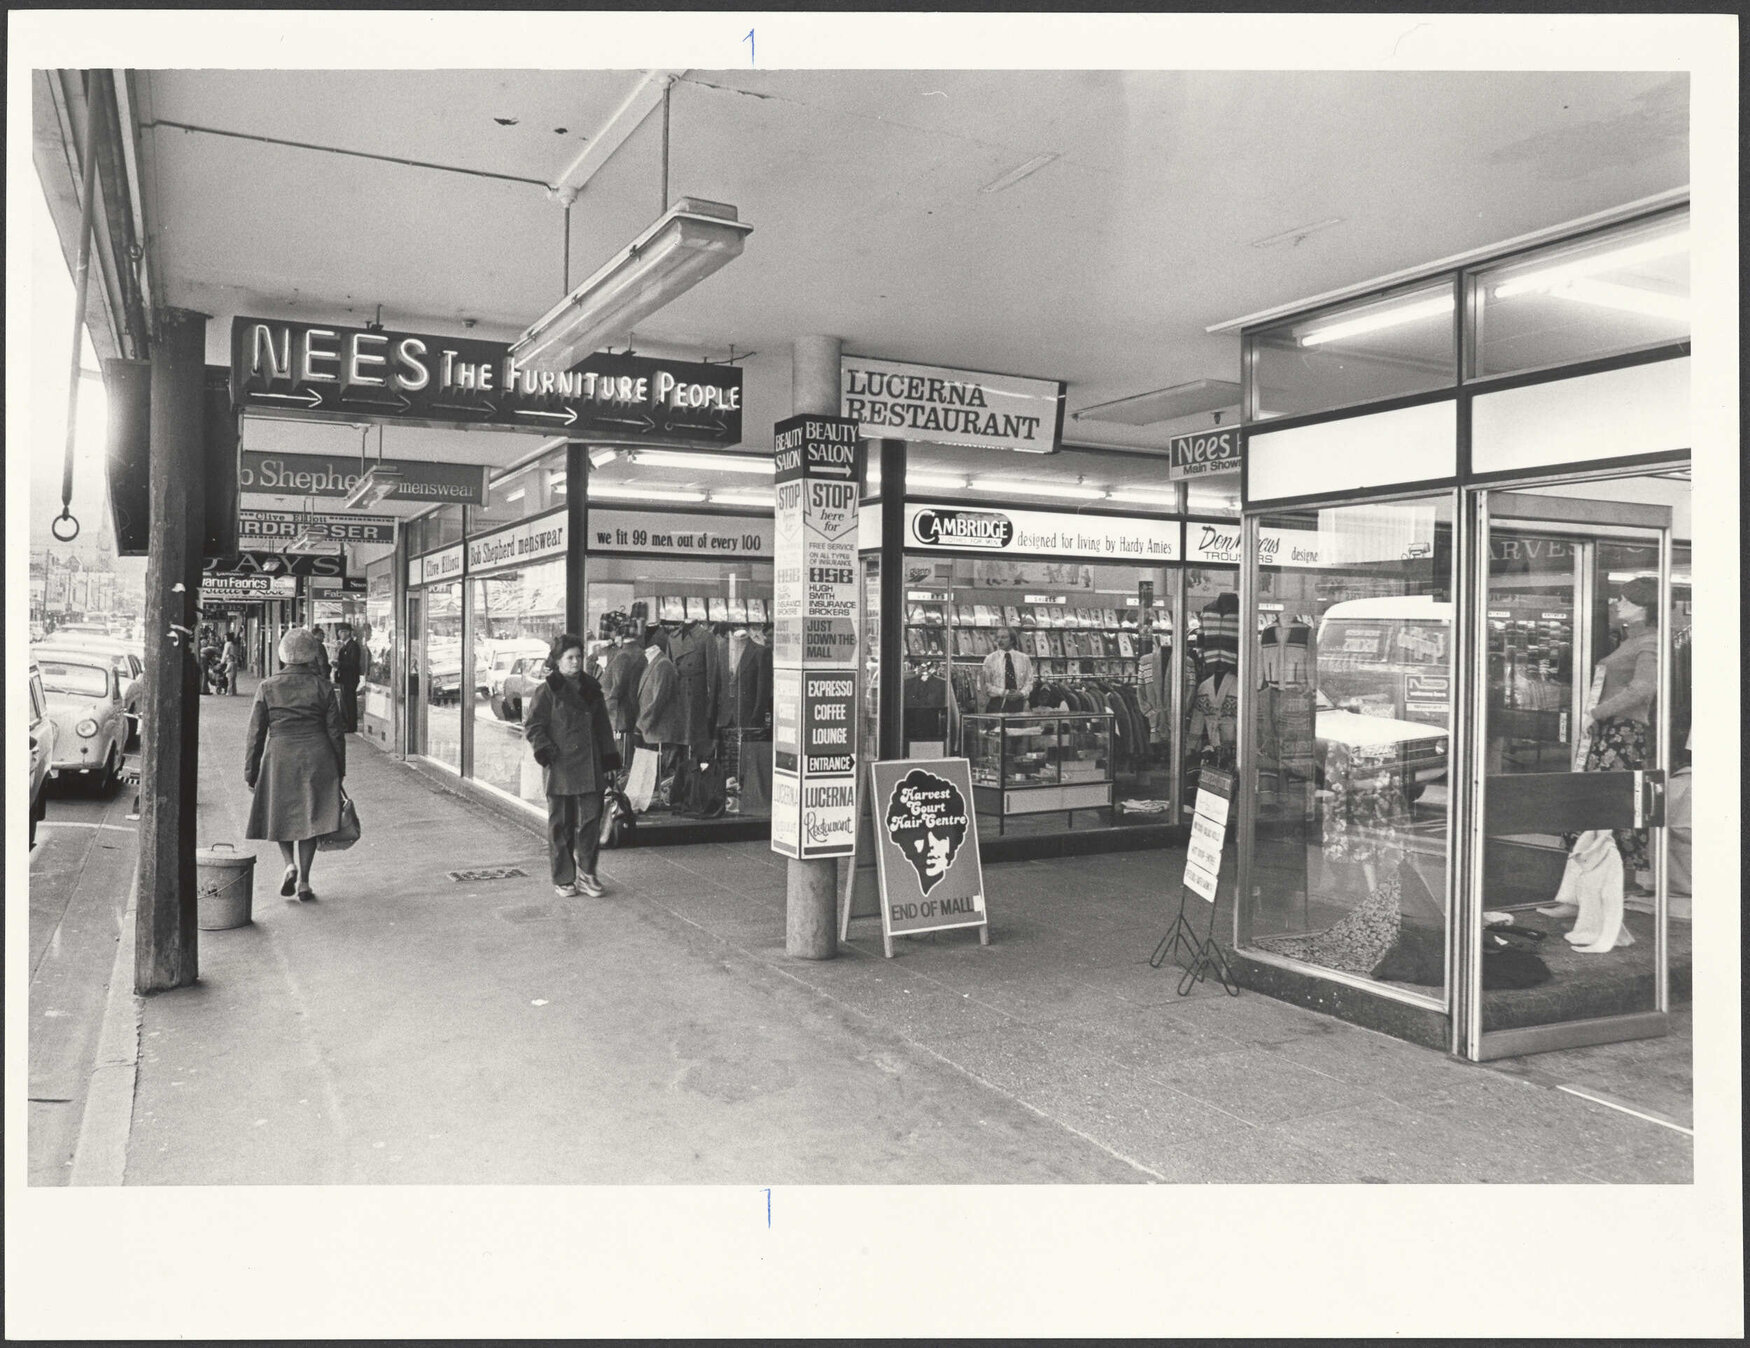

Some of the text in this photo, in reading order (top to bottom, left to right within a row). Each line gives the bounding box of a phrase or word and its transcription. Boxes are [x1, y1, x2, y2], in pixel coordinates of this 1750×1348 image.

[251, 324, 430, 391] NEES
[507, 357, 648, 401] FURNITURE
[656, 371, 741, 409] PEOPLE
[846, 368, 988, 408] LUCERNA
[846, 397, 1040, 440] RESTAURANT
[775, 427, 803, 452] BEAUTY
[805, 421, 859, 443] BEAUTY
[807, 442, 855, 463] SALON
[1177, 433, 1231, 465] Nees
[776, 448, 801, 472] SALON
[1183, 462, 1207, 475] Main
[260, 460, 360, 494] Shephe
[398, 481, 476, 497] menswear
[779, 483, 801, 510] STOP
[812, 483, 854, 510] STOP
[255, 513, 286, 521] Clive
[820, 509, 845, 521] here
[823, 520, 841, 532] for
[913, 508, 1008, 543] CAMBRIDGE
[470, 527, 563, 566] Bob Shepherd menswear
[597, 528, 762, 551] we fit 99 men out of every 100
[809, 542, 855, 551] FREE SERVICE
[1016, 530, 1173, 555] designed for living by Hardy Amies
[819, 559, 852, 567] INSURANCE
[1205, 551, 1274, 564] TROURS
[426, 559, 439, 577] Clive
[809, 584, 834, 593] HUGH
[809, 592, 835, 600] SMITH
[809, 600, 857, 609] INSURANCE
[809, 608, 850, 617] BROKERS
[806, 620, 833, 632] JUST
[806, 633, 855, 645] DOWN THE
[806, 646, 833, 658] MALL
[807, 680, 853, 698] EXPRESSO
[814, 703, 846, 720] COFFEE
[812, 728, 847, 745] LOUNGE
[809, 755, 851, 772] ENTRANCE
[805, 786, 854, 809] LUCERNA
[900, 786, 951, 804] Harvest
[906, 801, 946, 816] Court
[804, 811, 854, 844] Restaurant
[890, 812, 967, 832] Hair Centre
[891, 896, 975, 921] END OF MALL
